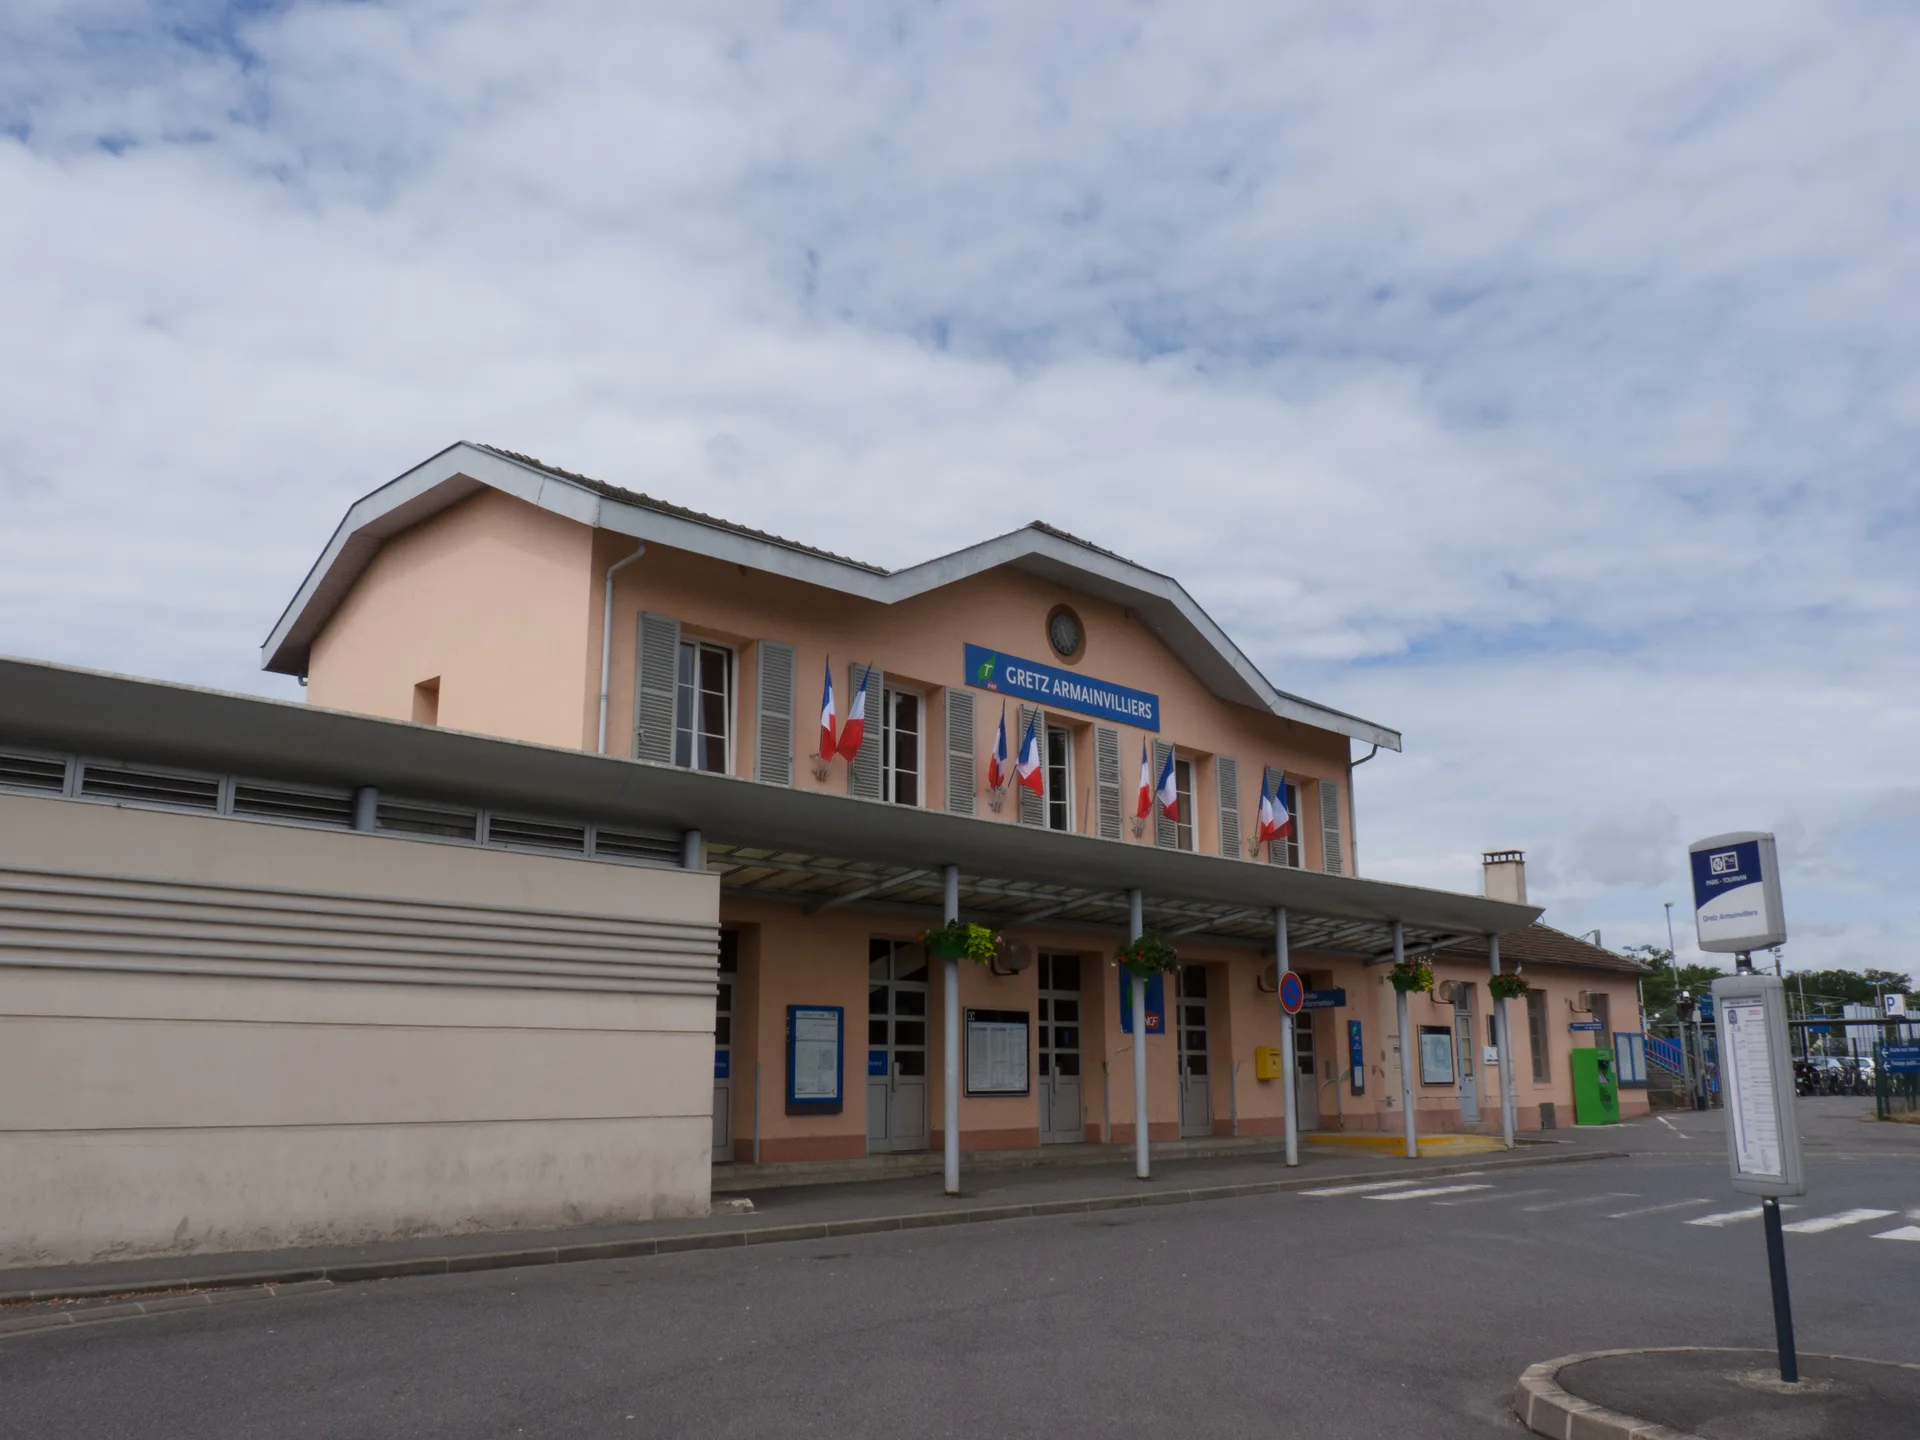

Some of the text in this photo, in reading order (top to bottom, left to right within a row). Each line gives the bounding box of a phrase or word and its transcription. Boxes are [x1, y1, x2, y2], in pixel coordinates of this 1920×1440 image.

[984, 663, 994, 677] T
[1006, 666, 1152, 719] GRETZ ARMAINVILLIERS
[1887, 997, 1895, 1012] P
[1144, 1016, 1158, 1027] NCF
